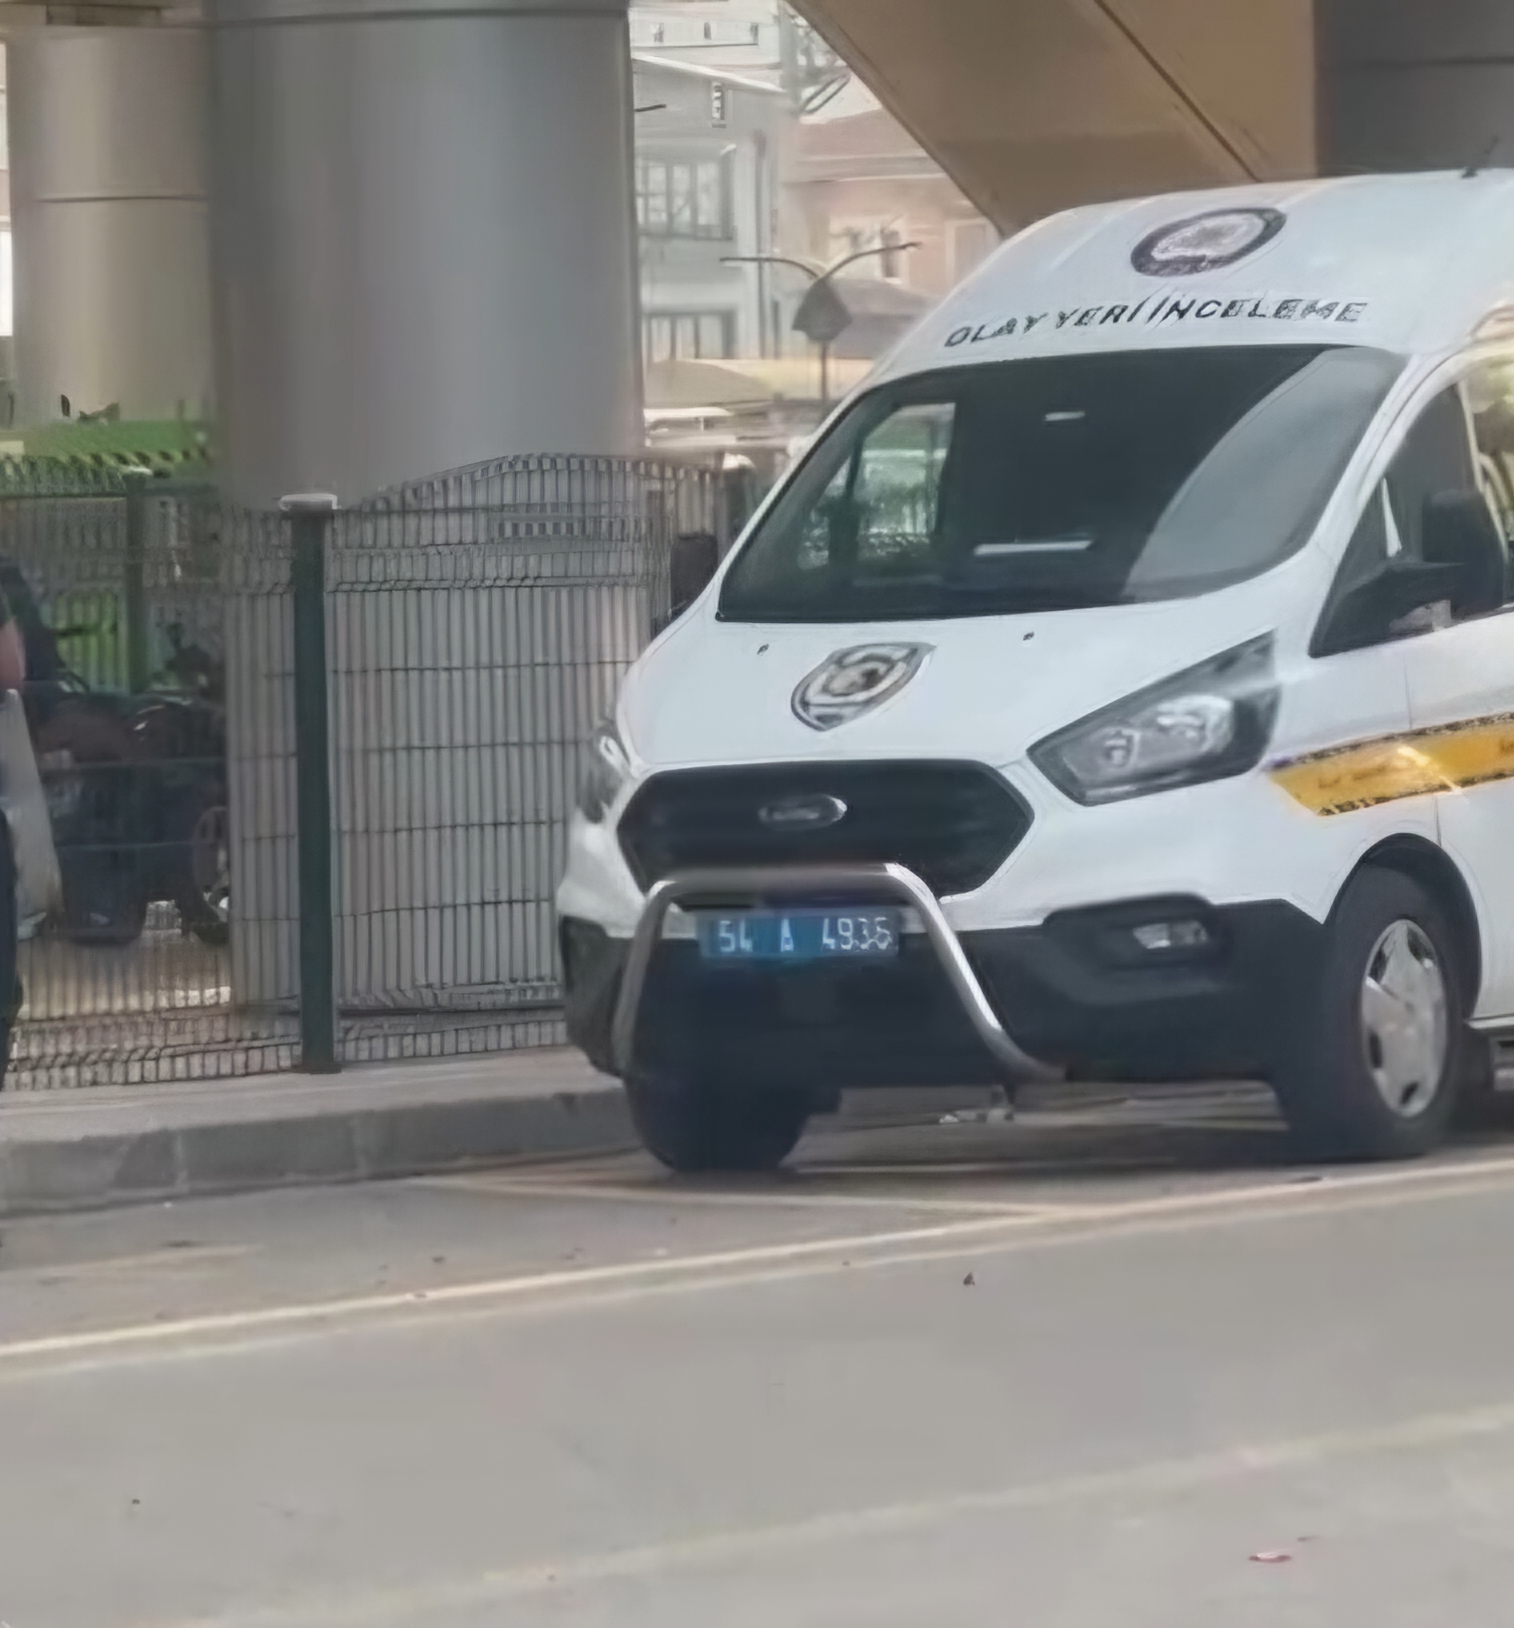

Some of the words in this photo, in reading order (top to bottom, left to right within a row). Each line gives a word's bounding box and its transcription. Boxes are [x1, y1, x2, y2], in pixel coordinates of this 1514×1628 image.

[944, 313, 1049, 347] OLAY
[718, 919, 753, 953] 54
[780, 917, 794, 951] A
